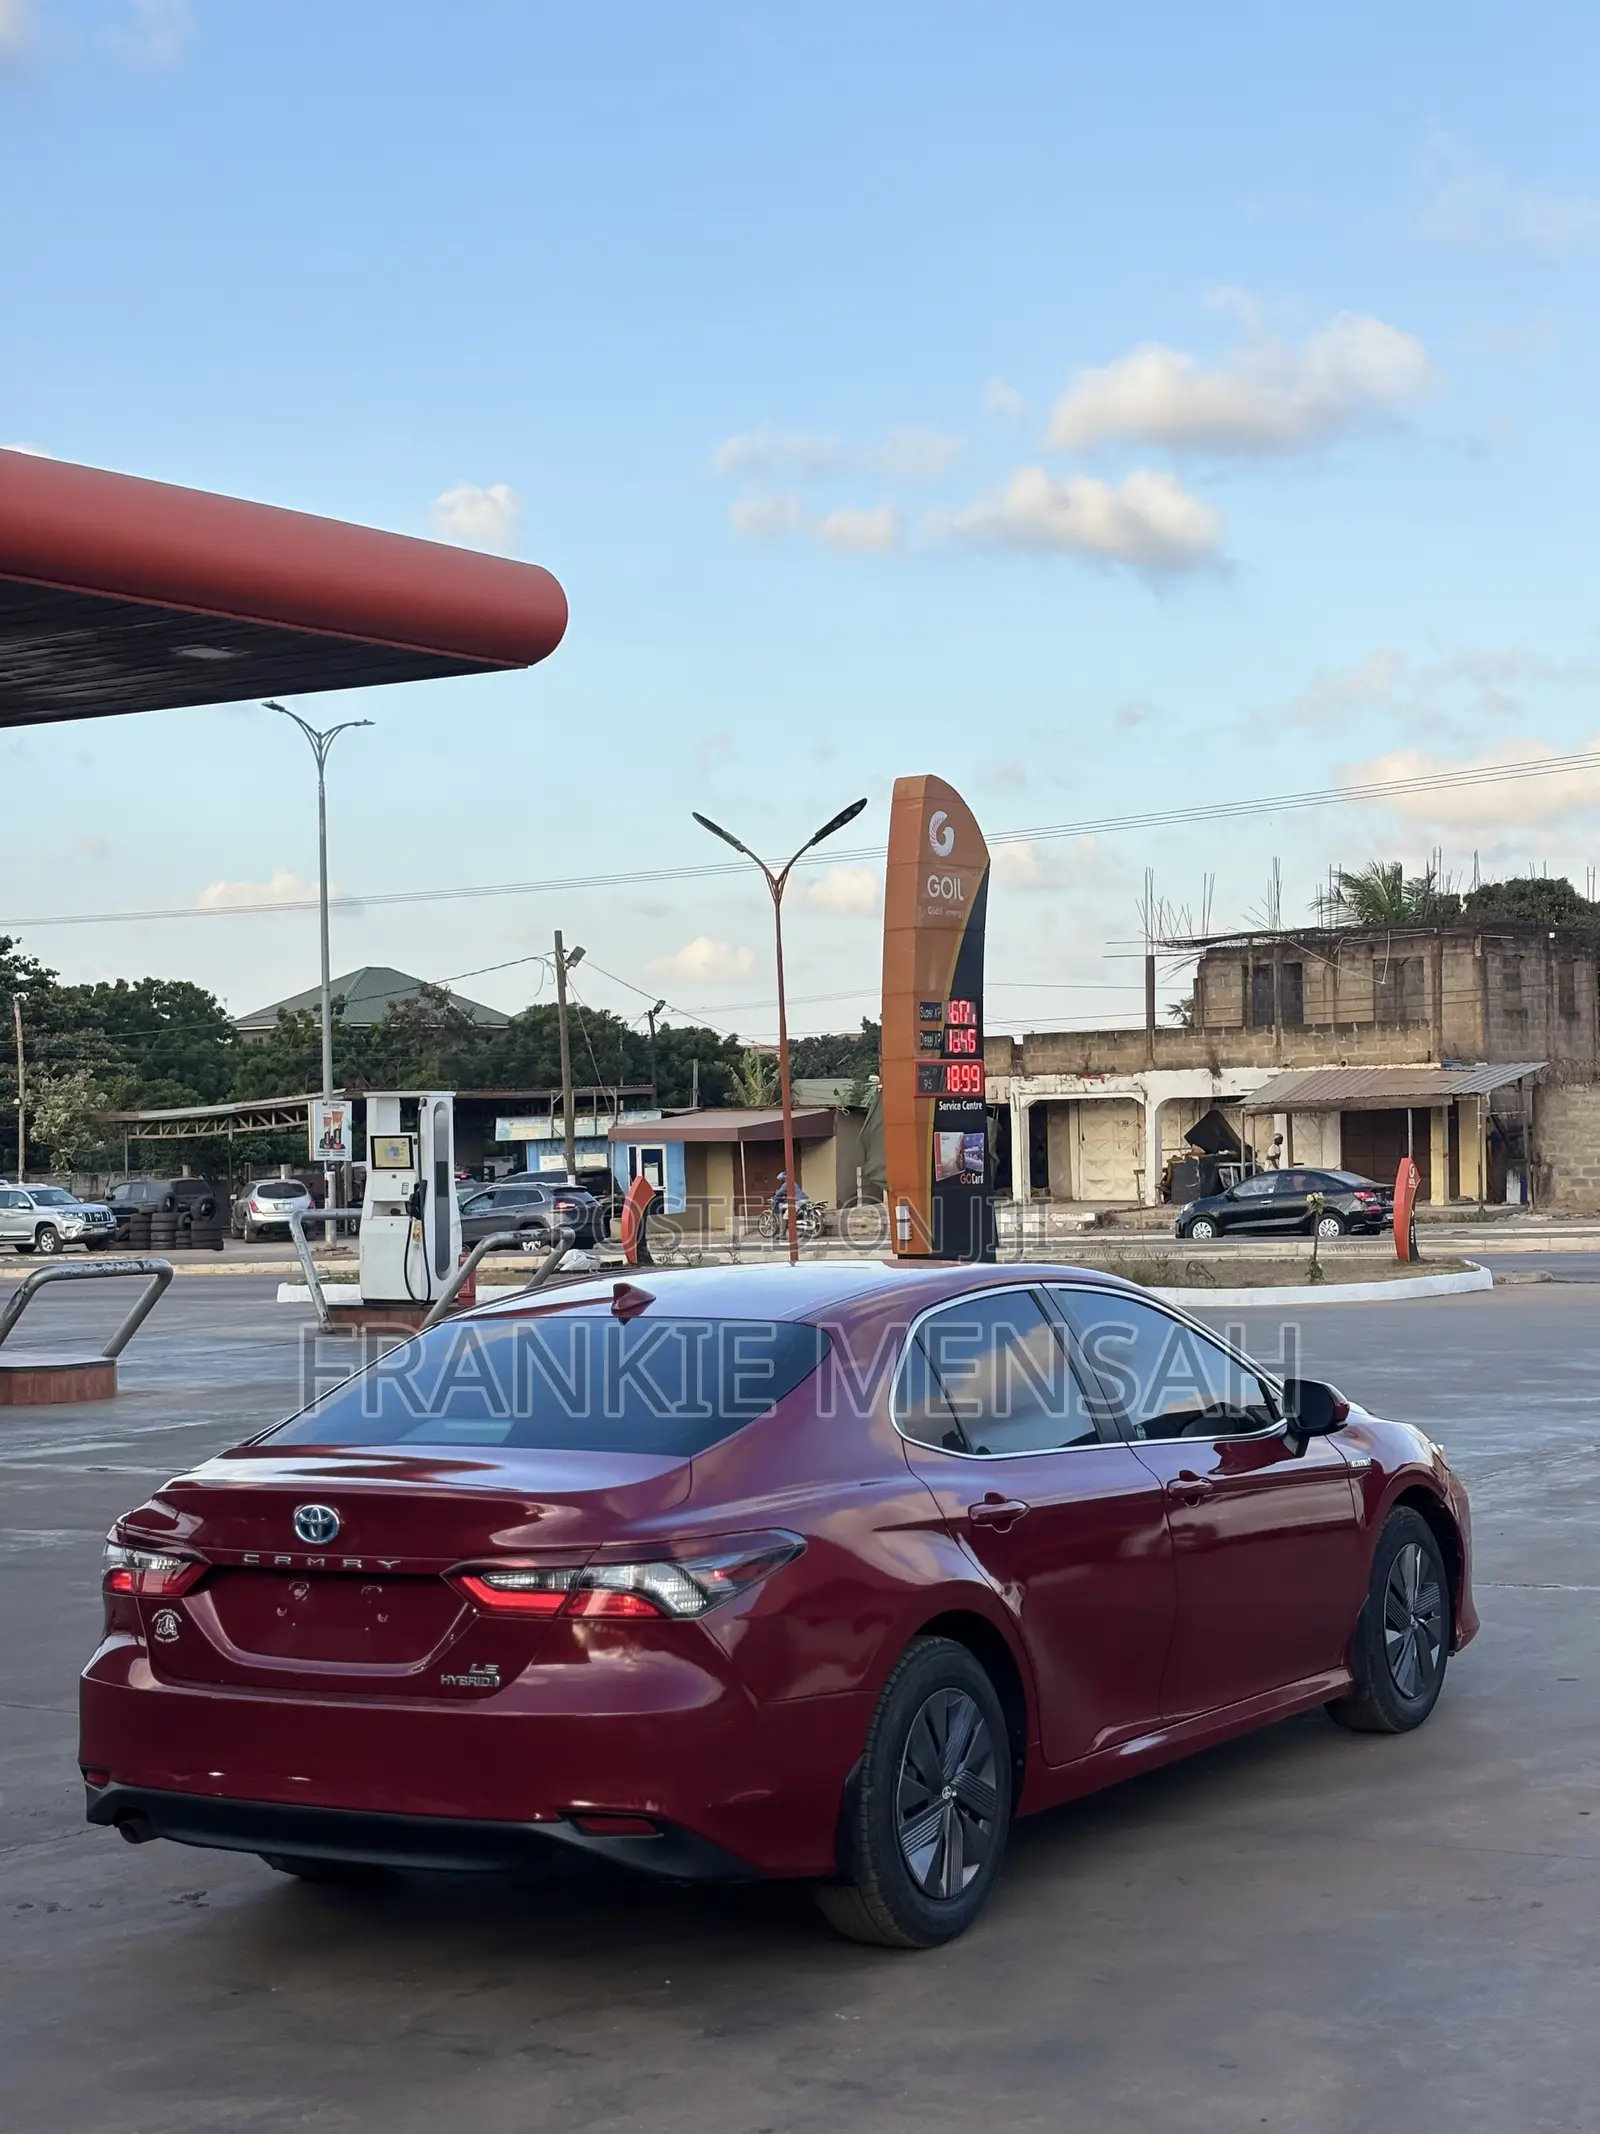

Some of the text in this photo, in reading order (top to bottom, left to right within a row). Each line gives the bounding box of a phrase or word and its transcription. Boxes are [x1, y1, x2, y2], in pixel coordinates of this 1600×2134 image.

[927, 875, 965, 901] GOIL
[923, 1079, 933, 1090] 95
[938, 1100, 983, 1111] Service Centre
[243, 1553, 401, 1569] CAMRY
[469, 1663, 500, 1674] LE
[440, 1674, 491, 1687] HYBRID
